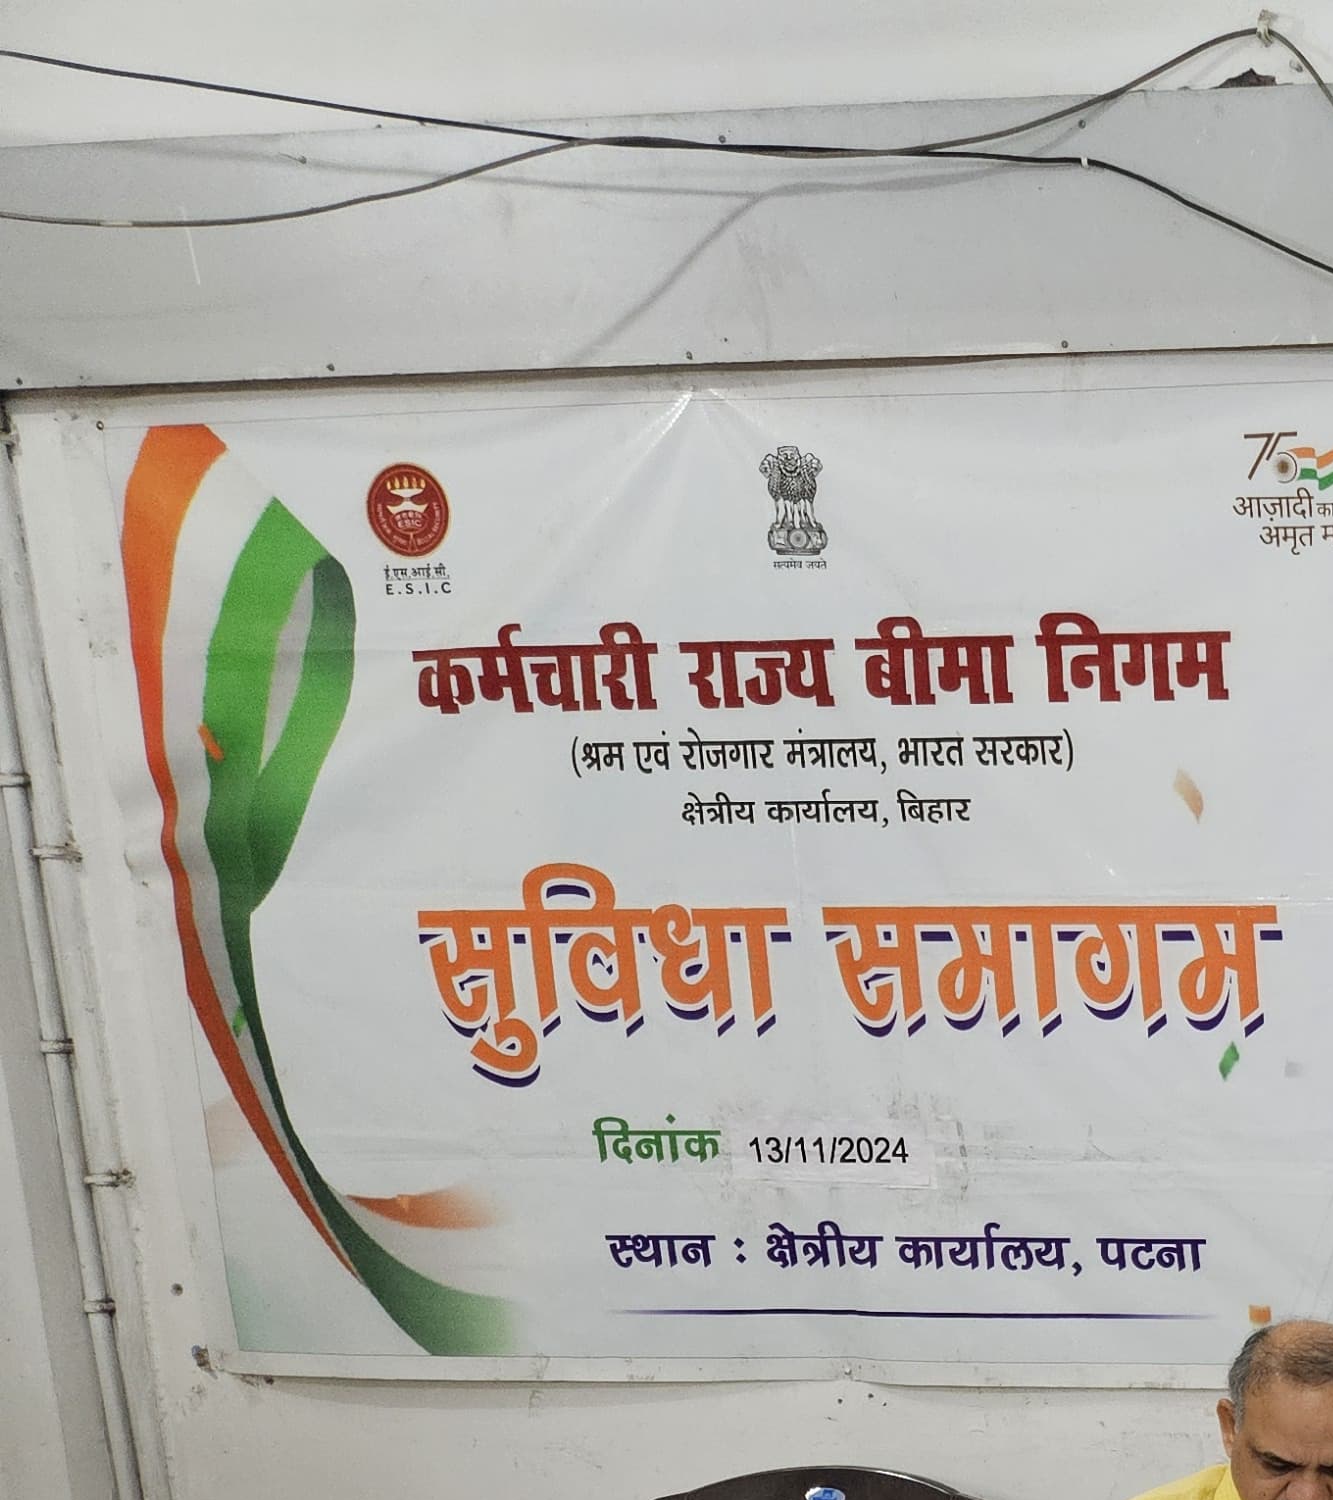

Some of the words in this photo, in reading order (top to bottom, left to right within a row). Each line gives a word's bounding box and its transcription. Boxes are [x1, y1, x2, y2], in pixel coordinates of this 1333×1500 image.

[1233, 487, 1314, 521] आज़ादी
[1260, 525, 1315, 555] अमृत
[412, 622, 658, 715] कर्मचारी
[679, 637, 835, 709] राज्य
[855, 615, 1014, 707] बीमा
[1035, 612, 1232, 702] निगम
[570, 735, 624, 778] (श्रम
[635, 729, 671, 772] एवं
[682, 728, 774, 771] रोजगार
[783, 730, 888, 775] मंत्रालय,
[897, 733, 964, 768] भारत
[973, 728, 1075, 772] सरकार)
[681, 790, 755, 826] क्षेत्रीय
[765, 789, 889, 830] कार्यालय,
[896, 790, 972, 823] बिहार
[417, 862, 791, 1089] सुविधा
[822, 904, 1284, 1040] समागम
[592, 1113, 722, 1165] दिनांक
[748, 1136, 910, 1167] 13/11/2024
[605, 1231, 717, 1273] स्थान
[766, 1219, 884, 1272] क्षेत्रीय
[895, 1223, 1083, 1278] कार्यालय,
[1099, 1233, 1208, 1274] पटना
